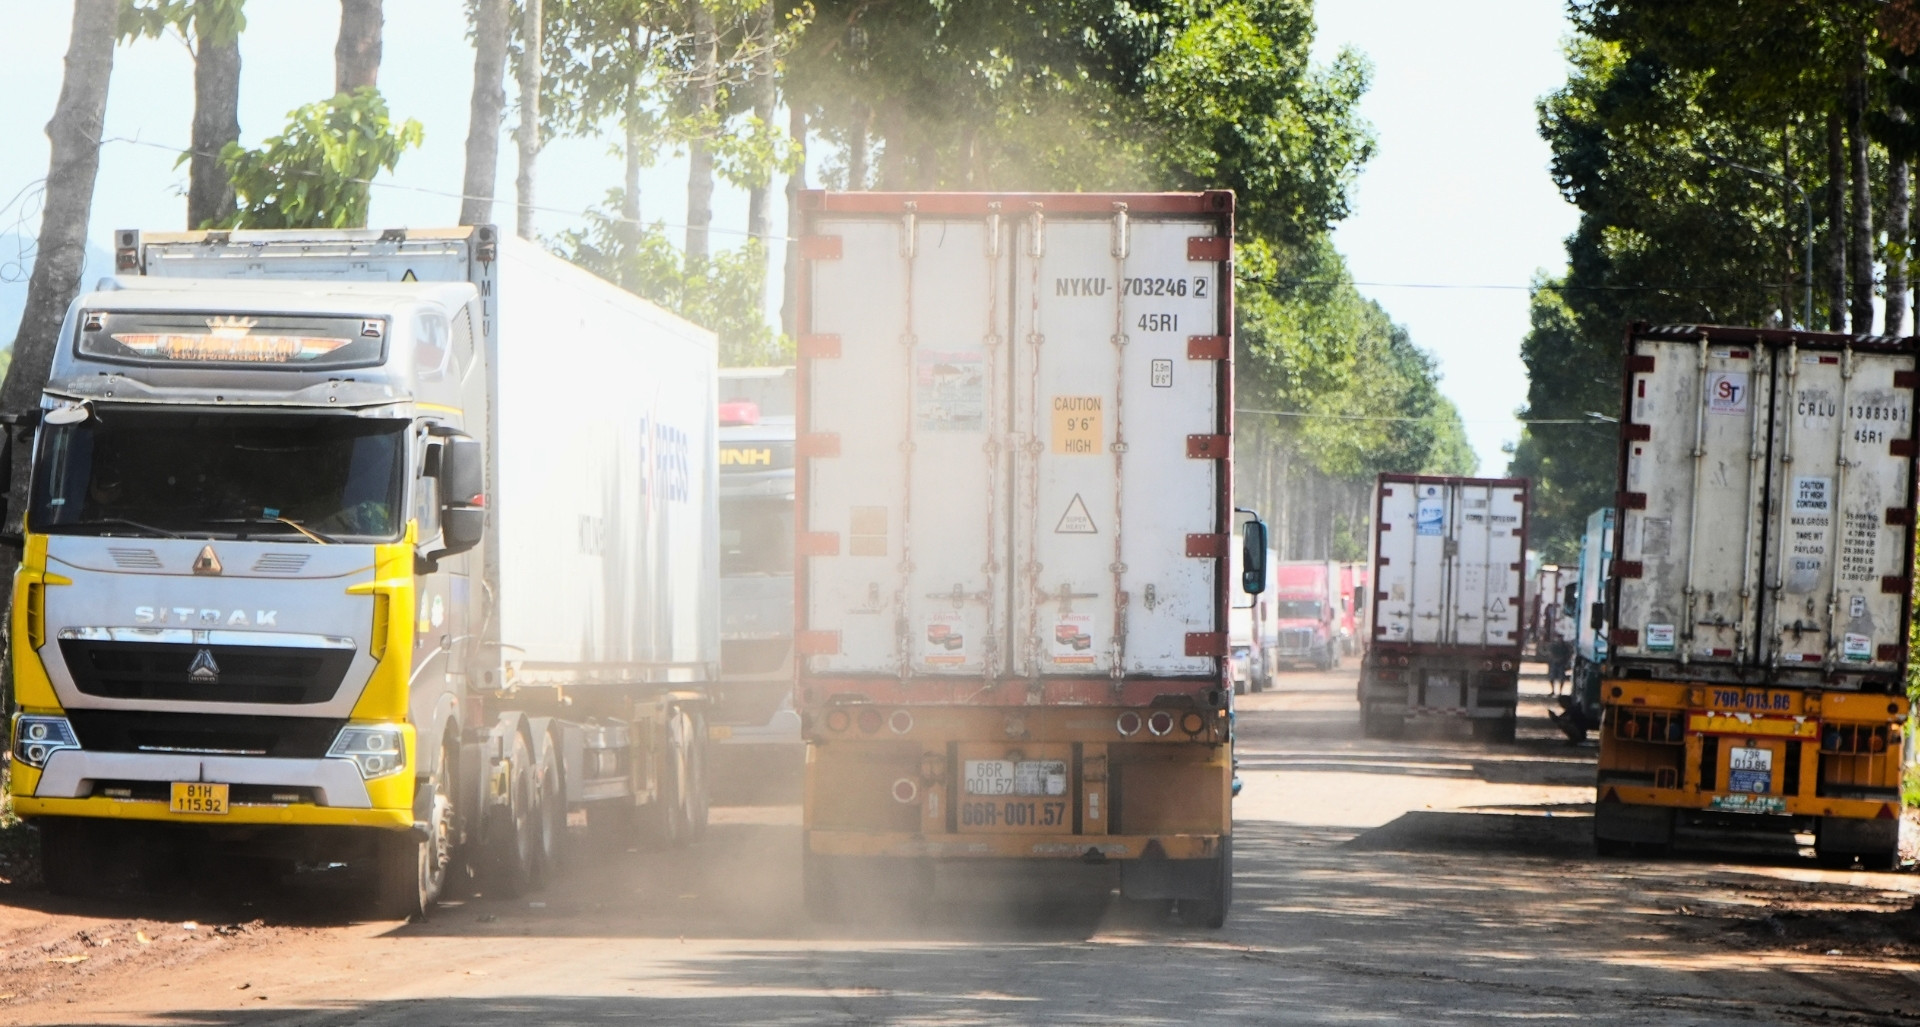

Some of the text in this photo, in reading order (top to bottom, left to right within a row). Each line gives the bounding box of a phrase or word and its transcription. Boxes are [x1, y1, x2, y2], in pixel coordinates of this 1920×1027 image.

[1056, 278, 1206, 297] NYKU- 703246 2
[481, 260, 491, 337] YMLU
[1055, 397, 1101, 411] CAUTION
[1798, 402, 1907, 421] CRLU 1388381
[1854, 430, 1883, 444] 45R1
[1065, 439, 1091, 453] HIGH
[639, 411, 689, 508] EXPRESS
[1793, 546, 1824, 554] PAYLOAD
[135, 606, 277, 626] SITRAK
[977, 762, 1002, 777] 66R
[188, 785, 212, 797] 81H
[179, 798, 221, 811] 115.92
[963, 802, 1066, 826] 66R-001.57
